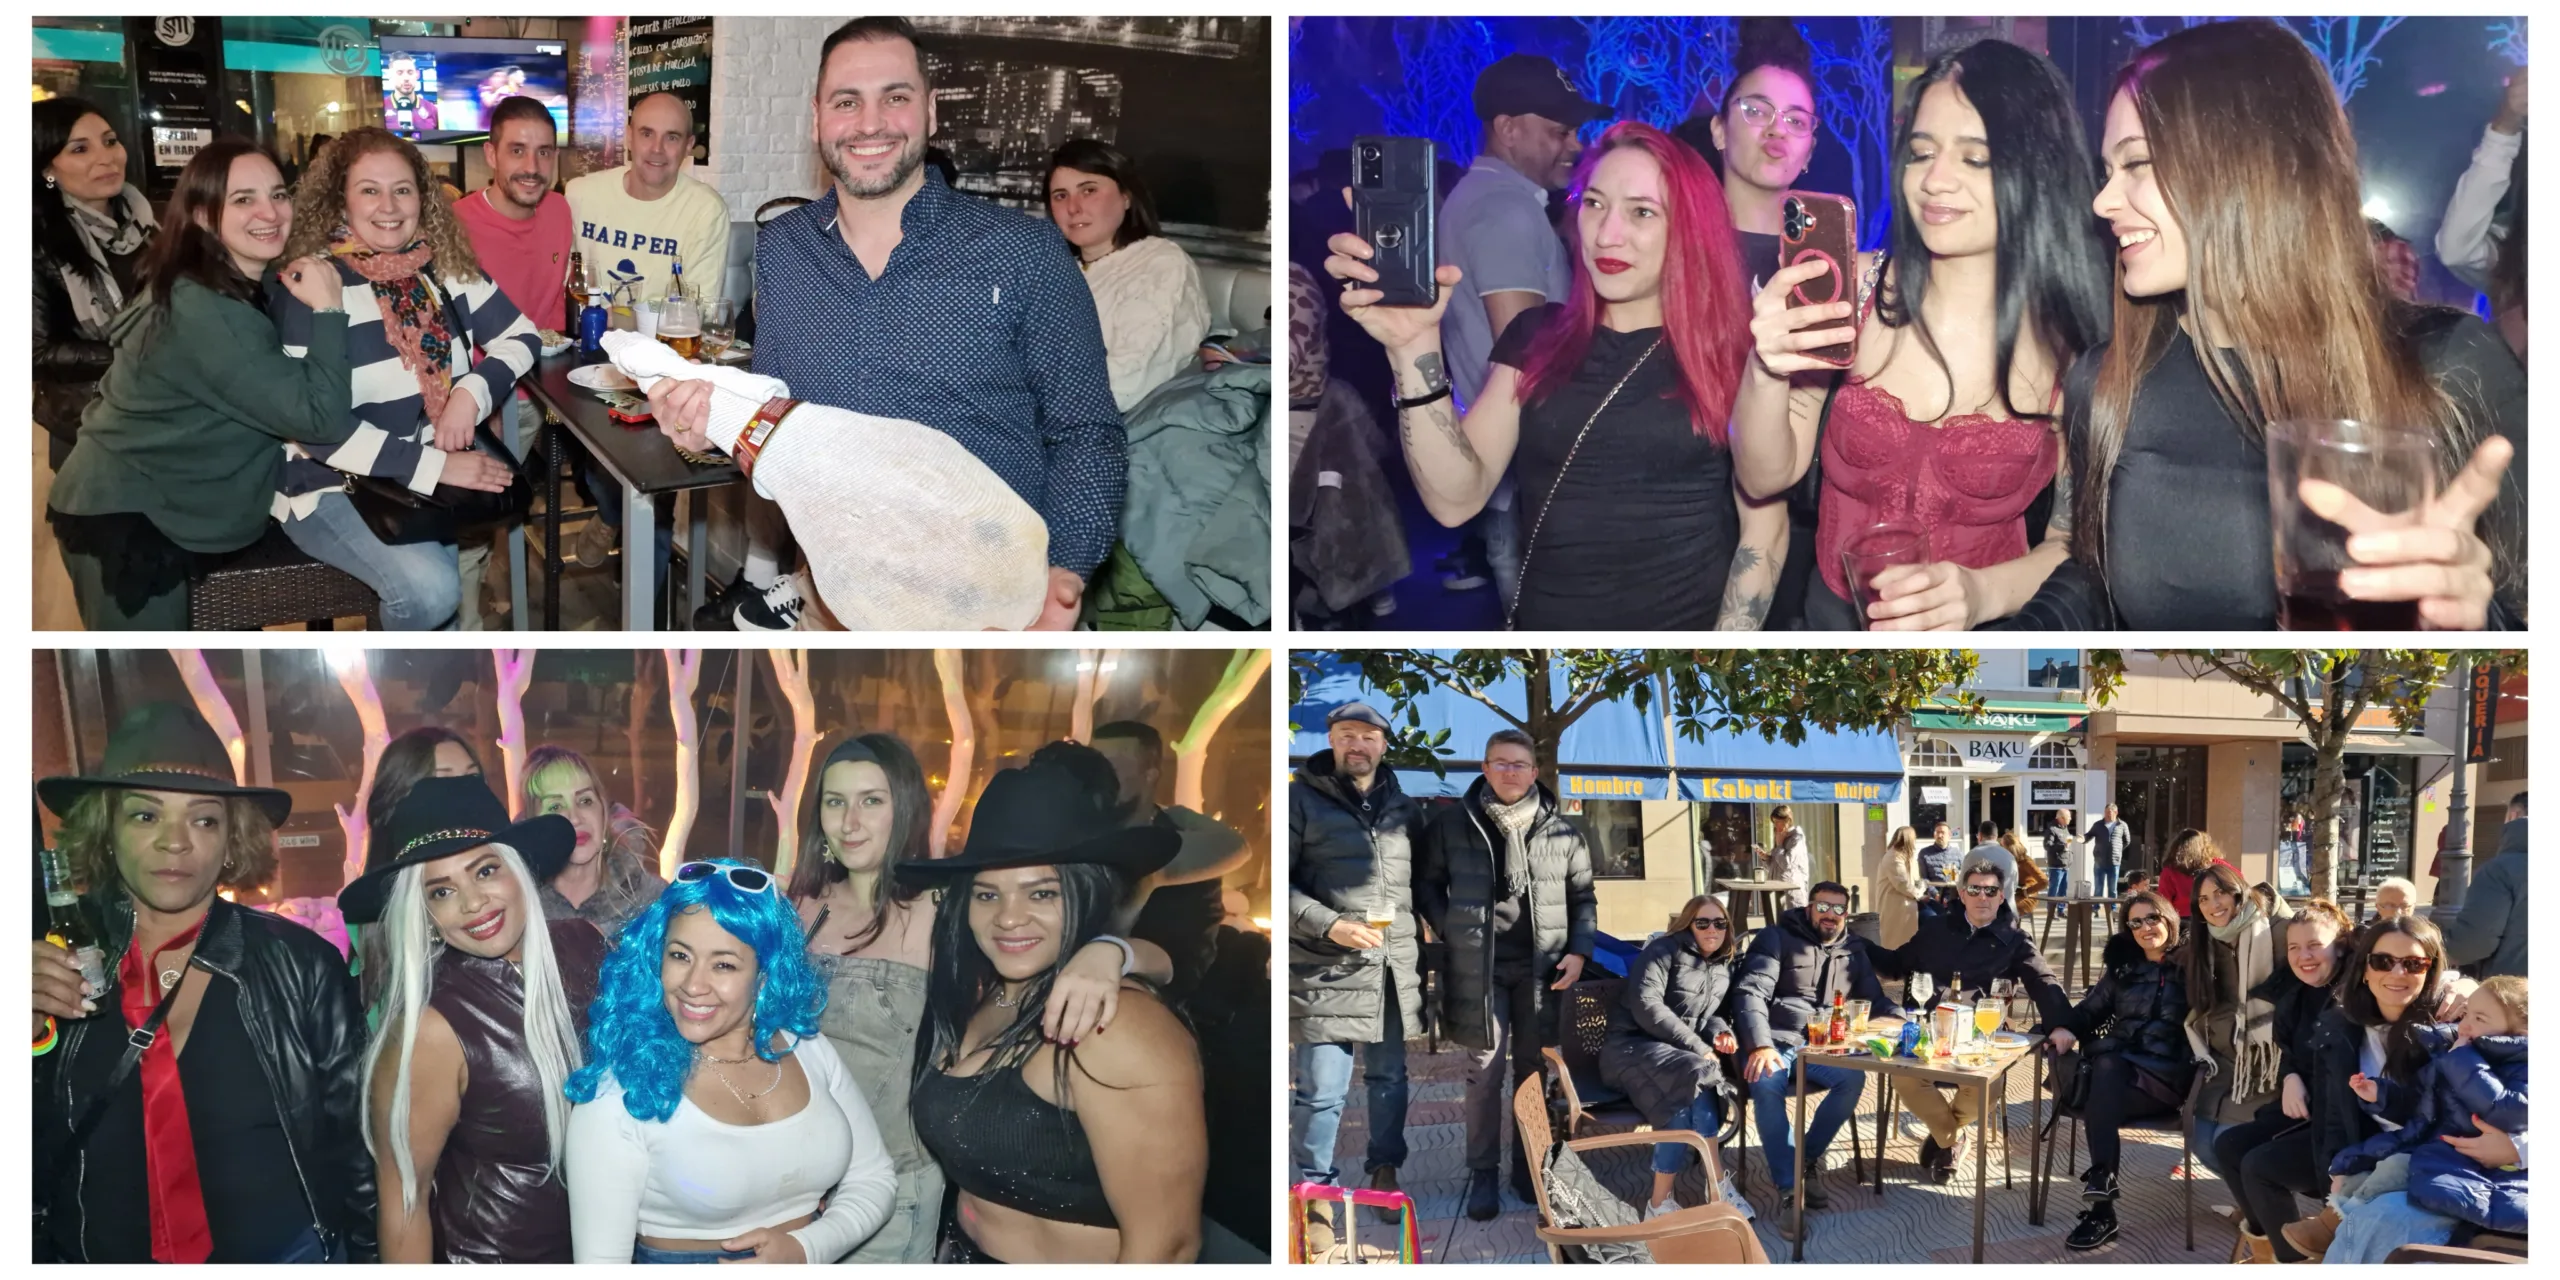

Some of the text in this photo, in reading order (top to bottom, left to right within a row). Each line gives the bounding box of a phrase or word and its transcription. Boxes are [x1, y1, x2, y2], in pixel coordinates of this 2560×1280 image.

[632, 20, 660, 38] PATATAS
[632, 32, 708, 56] CALLOS CON GARBANZOS
[633, 56, 697, 78] TOSTA DE MORCILLA
[661, 81, 670, 91] DE
[671, 77, 691, 90] POLLO
[158, 144, 204, 156] EN BARR
[581, 221, 678, 256] HARPER
[2471, 662, 2491, 757] UQUERÍA
[1975, 713, 2037, 727] BAKU
[1969, 740, 2024, 759] BAKU
[1570, 776, 1644, 795] Hombre
[1702, 778, 1793, 800] Kabuki
[1834, 782, 1880, 800] Mujer
